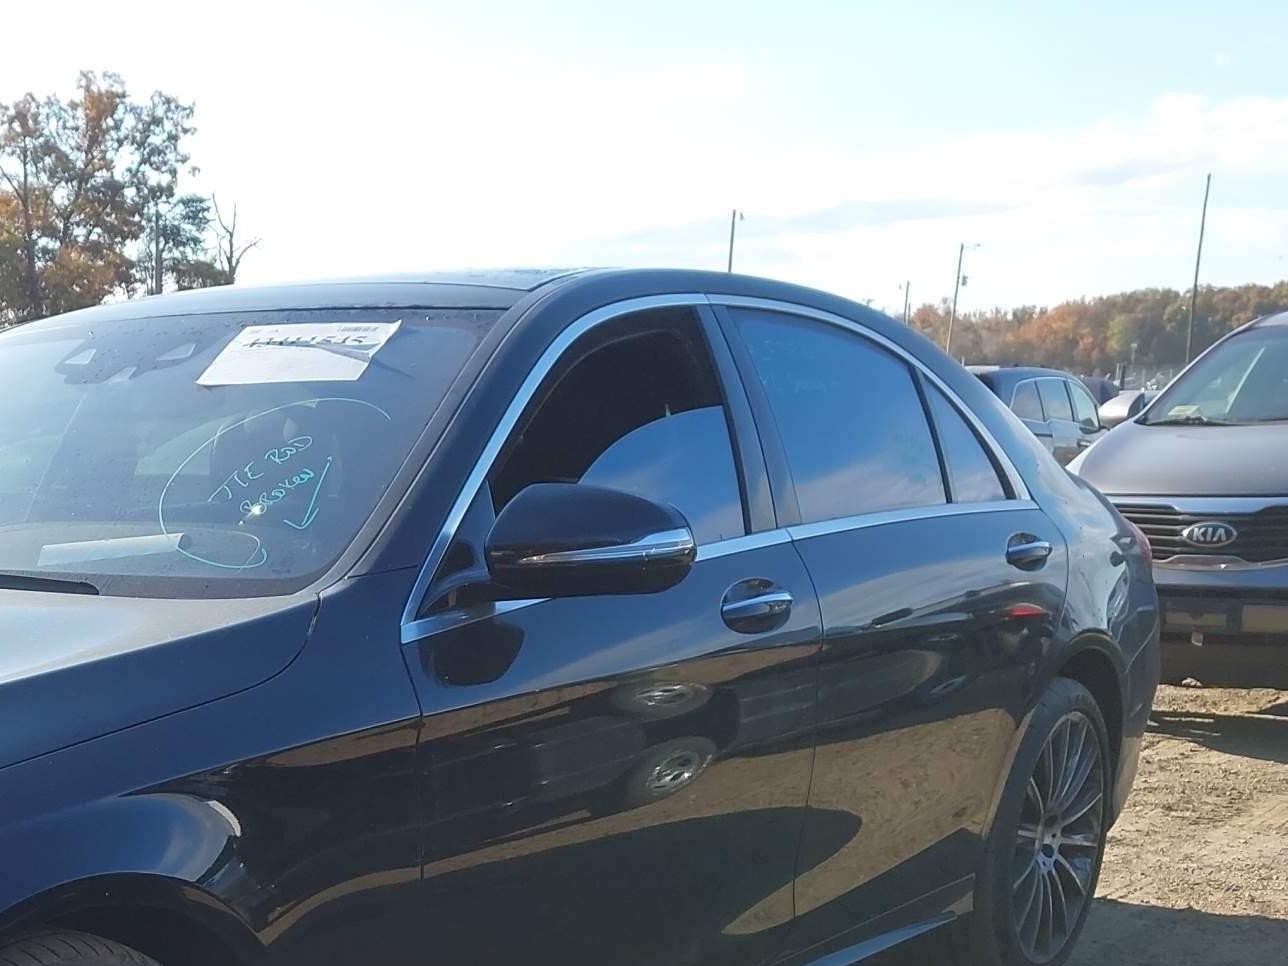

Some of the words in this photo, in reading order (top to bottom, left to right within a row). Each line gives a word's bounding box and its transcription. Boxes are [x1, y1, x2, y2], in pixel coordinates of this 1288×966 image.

[207, 460, 265, 502] TIE
[264, 435, 313, 464] ROD
[1193, 527, 1227, 541] KIA
